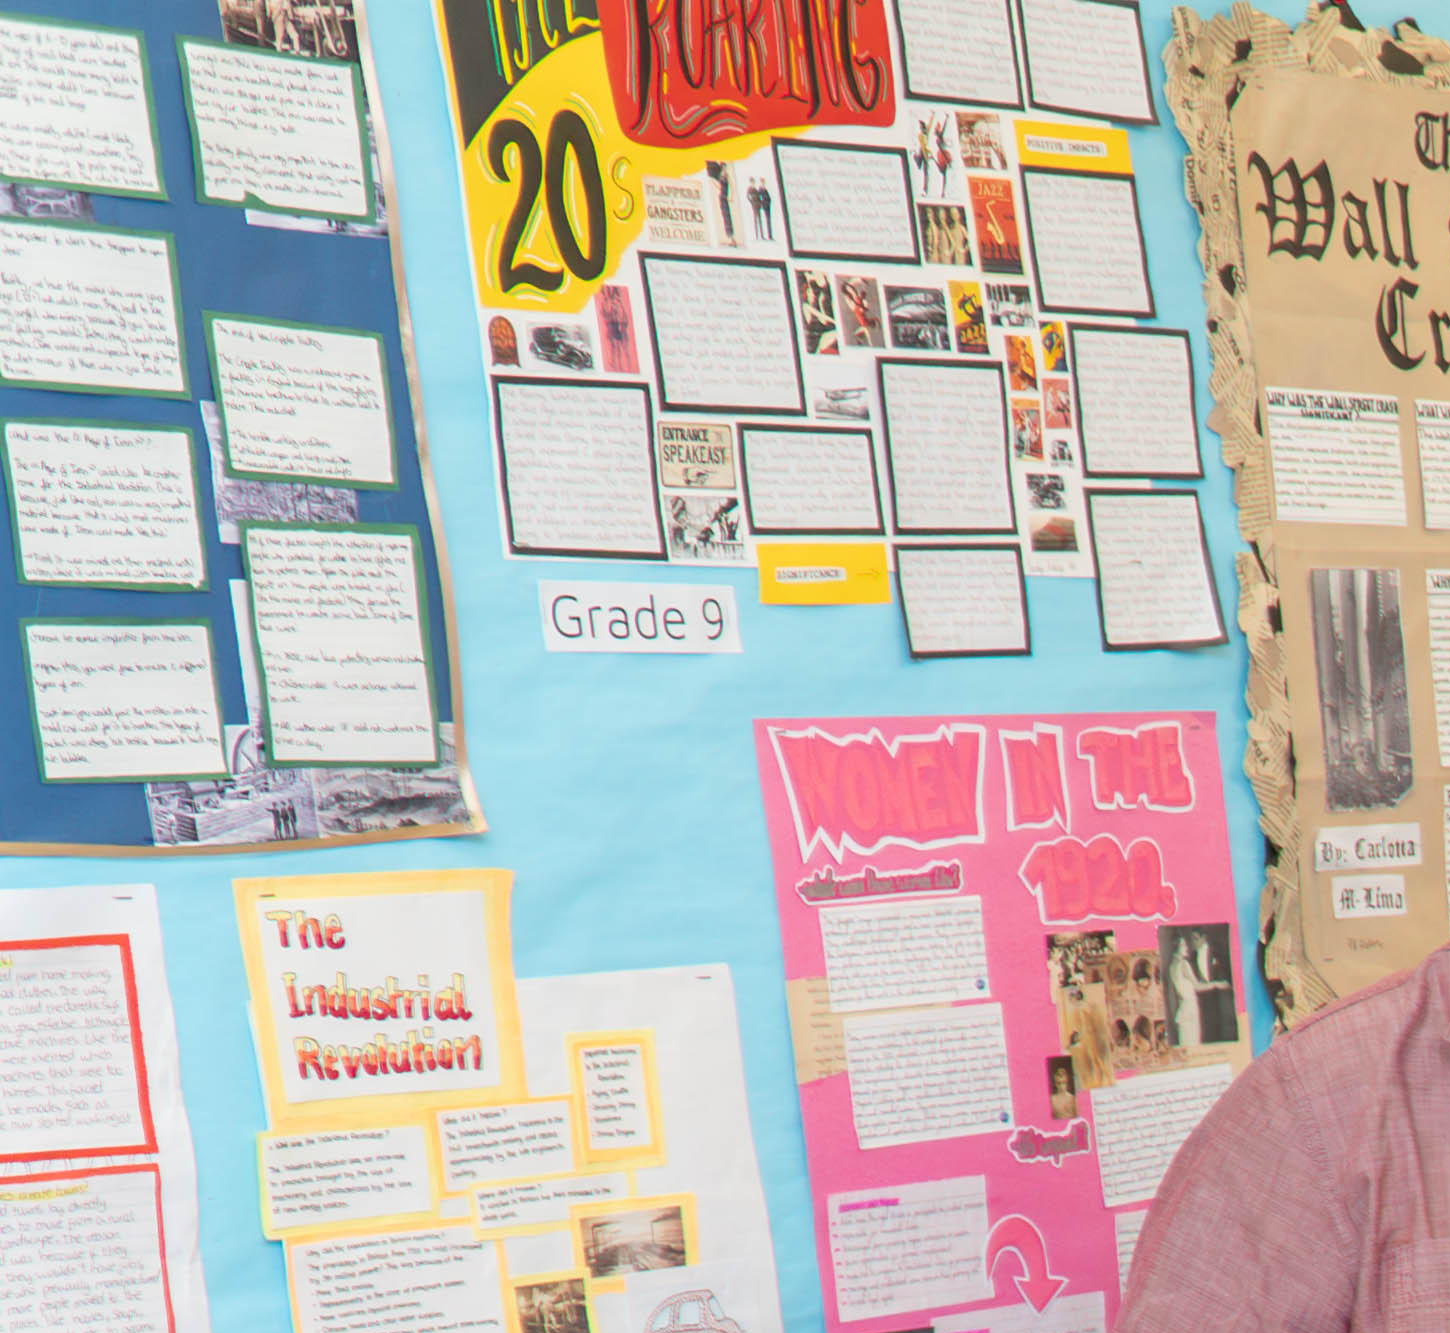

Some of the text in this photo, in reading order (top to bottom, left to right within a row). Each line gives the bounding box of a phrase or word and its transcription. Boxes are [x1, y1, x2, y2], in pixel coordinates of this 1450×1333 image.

[978, 183, 1003, 197] JAZZ
[646, 205, 704, 222] GANGSTERS
[1248, 151, 1420, 271] Wall
[649, 225, 705, 242] WELCOME
[662, 426, 708, 442] ENTRANCE
[662, 445, 726, 465] SPEAKEASY
[1431, 576, 1450, 589] WHY
[552, 594, 724, 640] Grade 9
[784, 734, 973, 837] WOMEN
[1083, 731, 1188, 800] THE
[1355, 836, 1416, 859] Carlotta
[264, 910, 346, 950] The
[281, 971, 473, 1021] Industrial
[293, 1026, 482, 1081] Revolution
